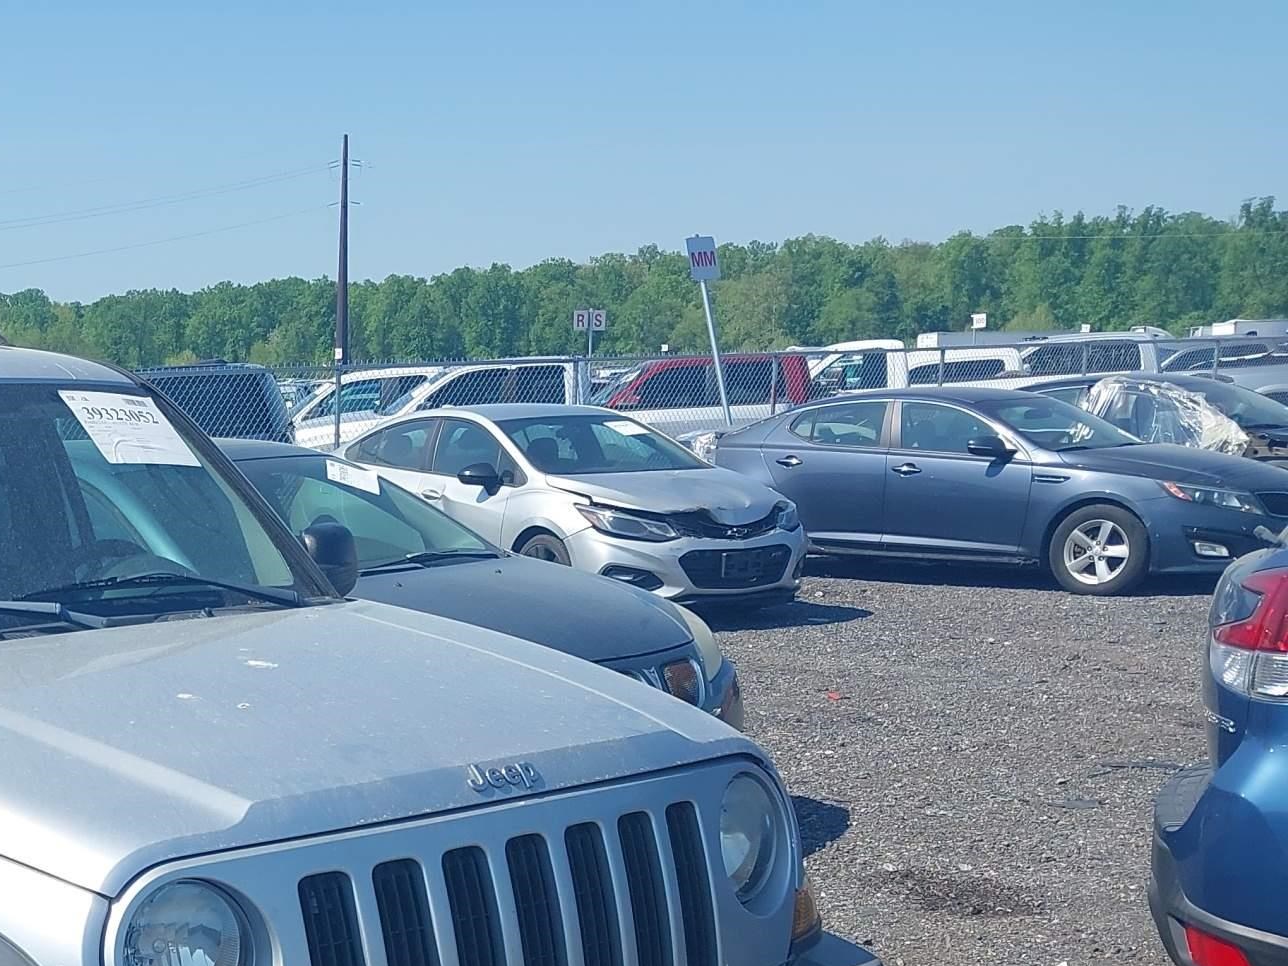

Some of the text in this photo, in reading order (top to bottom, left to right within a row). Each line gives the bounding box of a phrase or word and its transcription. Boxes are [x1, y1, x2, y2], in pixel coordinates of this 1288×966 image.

[691, 250, 717, 268] MM
[577, 314, 602, 328] R S
[82, 407, 159, 424] 39323052
[467, 763, 538, 793] Jeep
